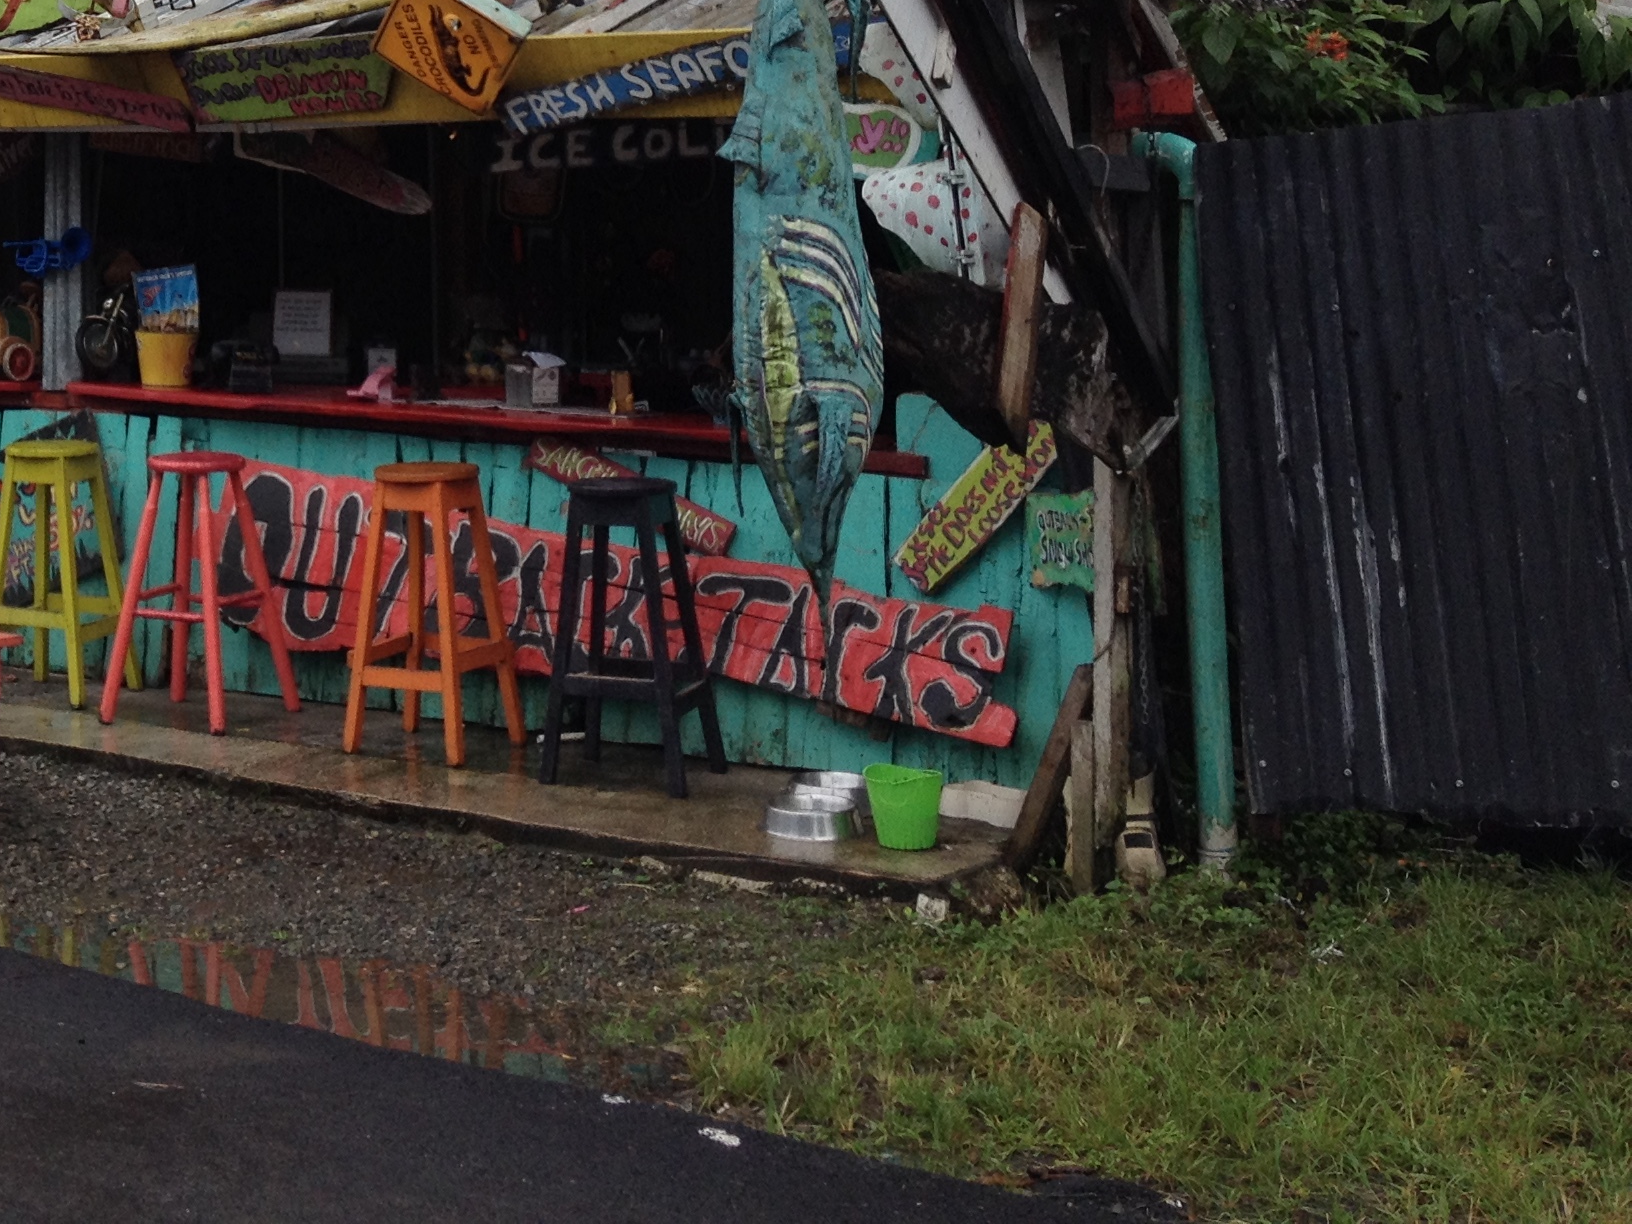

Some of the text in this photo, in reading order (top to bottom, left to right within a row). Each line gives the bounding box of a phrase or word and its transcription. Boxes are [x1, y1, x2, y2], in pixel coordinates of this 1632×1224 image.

[394, 21, 426, 77] DANGER
[401, 3, 452, 96] CROCODILES
[463, 34, 481, 55] NO
[506, 76, 616, 135] FRESH
[491, 122, 730, 173] ICE COL
